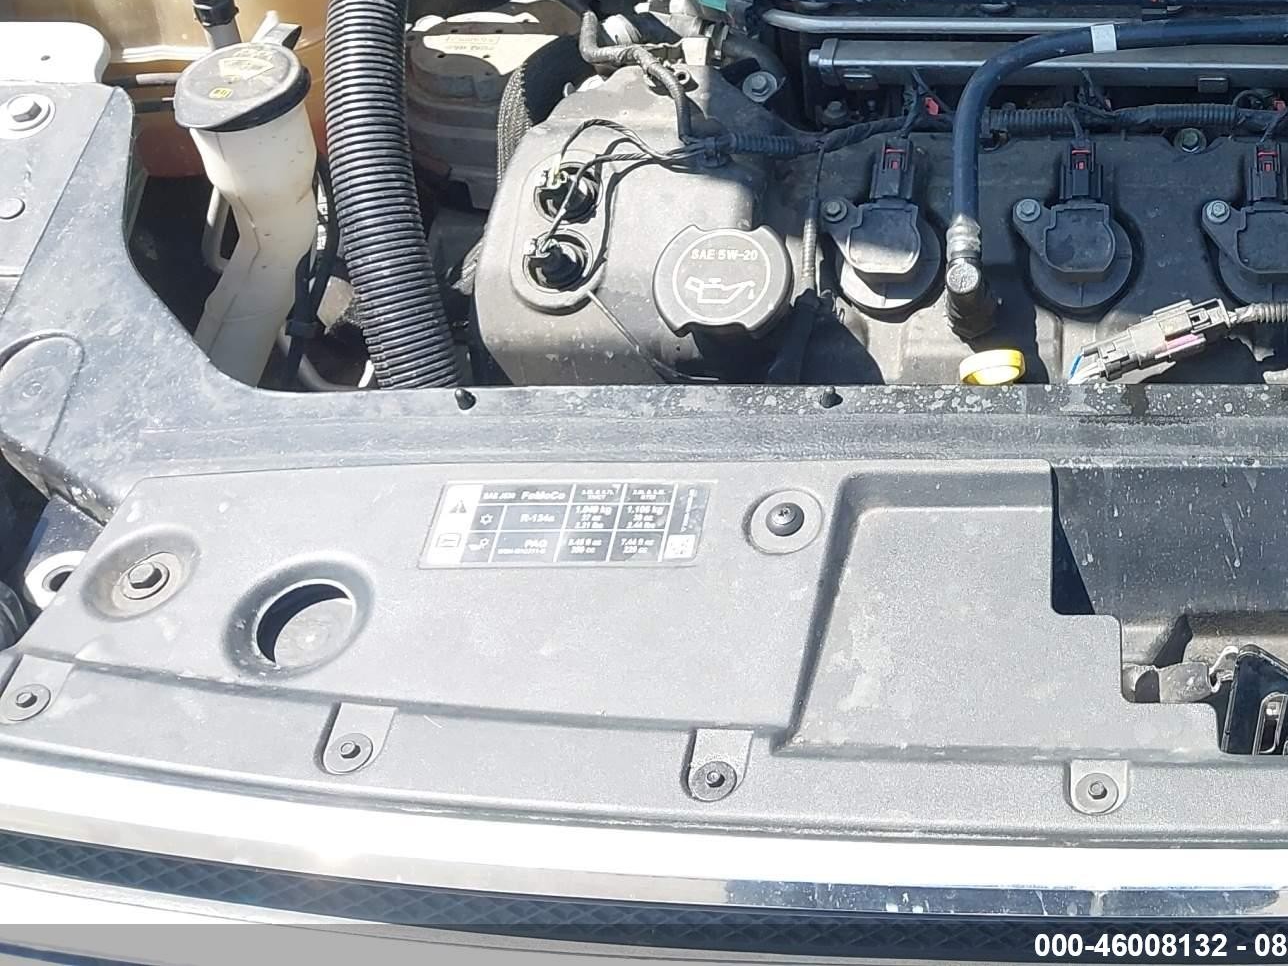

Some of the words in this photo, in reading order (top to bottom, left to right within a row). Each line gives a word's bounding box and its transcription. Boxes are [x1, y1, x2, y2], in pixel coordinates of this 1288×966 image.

[690, 249, 716, 260] SAE
[717, 249, 759, 261] 5W-20
[521, 490, 566, 500] FoMoCo
[651, 505, 665, 516] kg
[520, 513, 555, 523] R-134a
